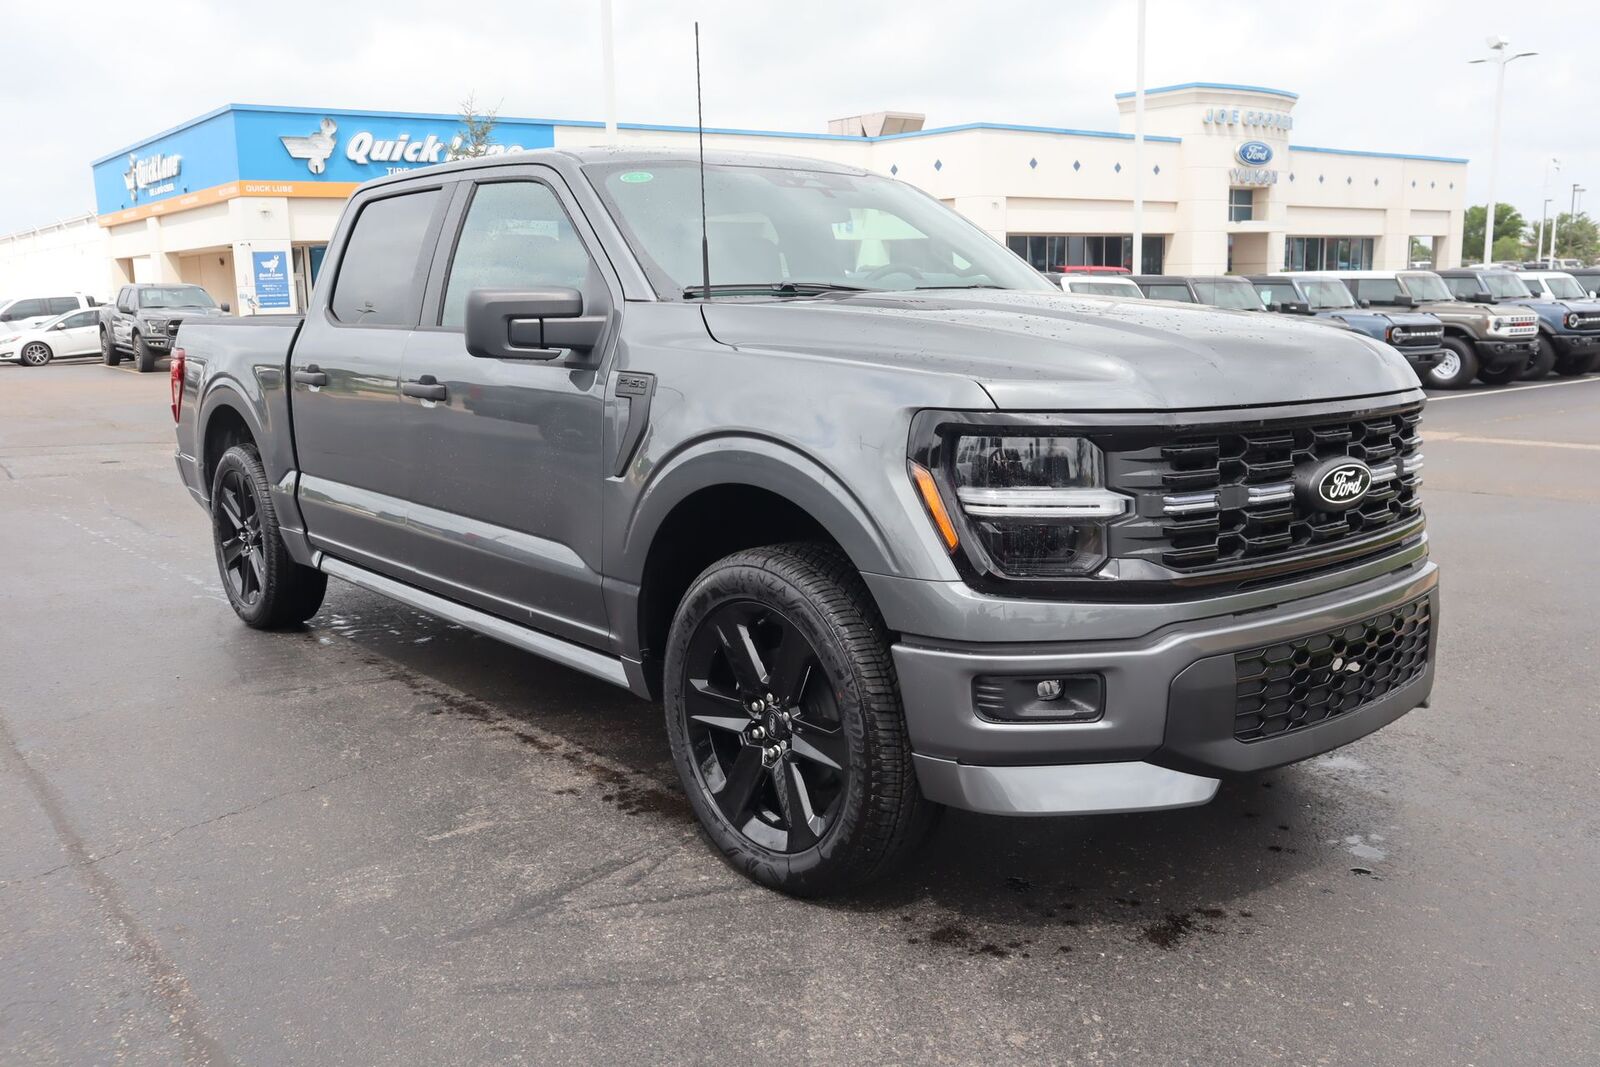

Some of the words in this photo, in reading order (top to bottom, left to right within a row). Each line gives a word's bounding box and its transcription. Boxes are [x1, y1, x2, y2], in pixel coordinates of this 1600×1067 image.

[345, 131, 444, 165] Quick
[1246, 145, 1268, 160] Ford
[245, 184, 270, 193] QUICK
[272, 185, 293, 193] LUBE
[1329, 470, 1363, 498] Ford
